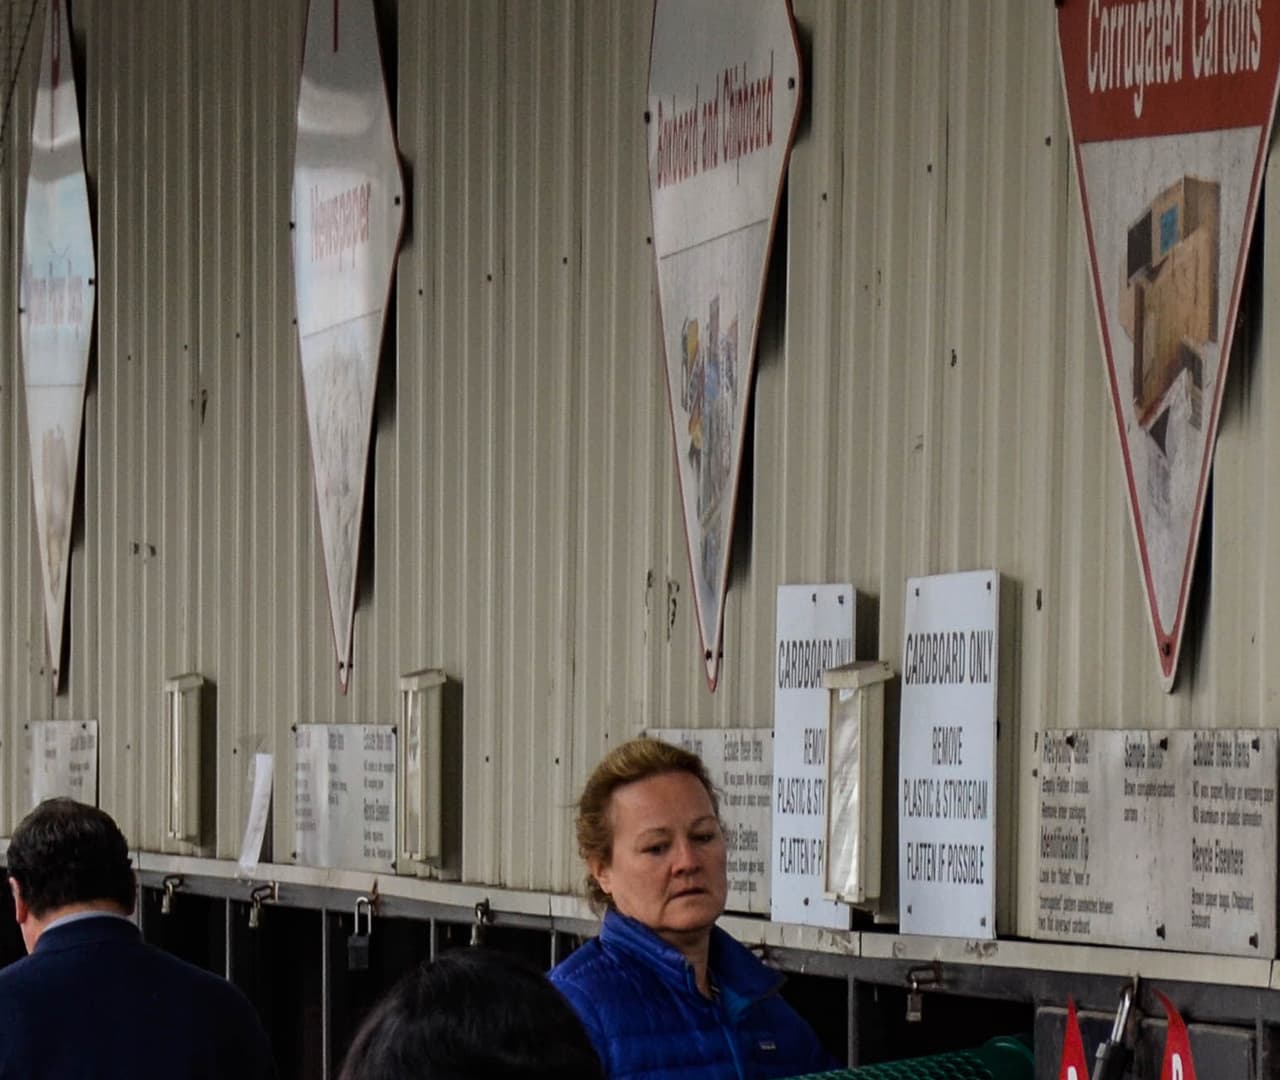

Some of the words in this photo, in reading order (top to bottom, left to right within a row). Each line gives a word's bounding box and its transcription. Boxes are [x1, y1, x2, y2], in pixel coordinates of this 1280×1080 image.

[1087, 0, 1184, 119] Corrugated
[1191, 0, 1262, 79] Cartons
[657, 85, 699, 190] Boxboard
[703, 74, 719, 169] and
[722, 50, 774, 184] Chipboard
[310, 182, 371, 272] Newspaper
[904, 632, 966, 686] CARDBOARD
[968, 629, 994, 685] ONLY
[804, 727, 826, 765] REMOV
[931, 726, 964, 767] REMOVE
[777, 777, 806, 814] PLASTIC
[807, 779, 812, 815] &
[903, 779, 934, 820] PLASTIC
[935, 782, 941, 820] &
[943, 780, 989, 820] STYROFOAM
[780, 837, 809, 876] FLATTEN
[810, 839, 817, 876] IF
[906, 841, 936, 884] FLATTEN
[937, 843, 945, 884] IF
[947, 844, 985, 886] POSSIBLE
